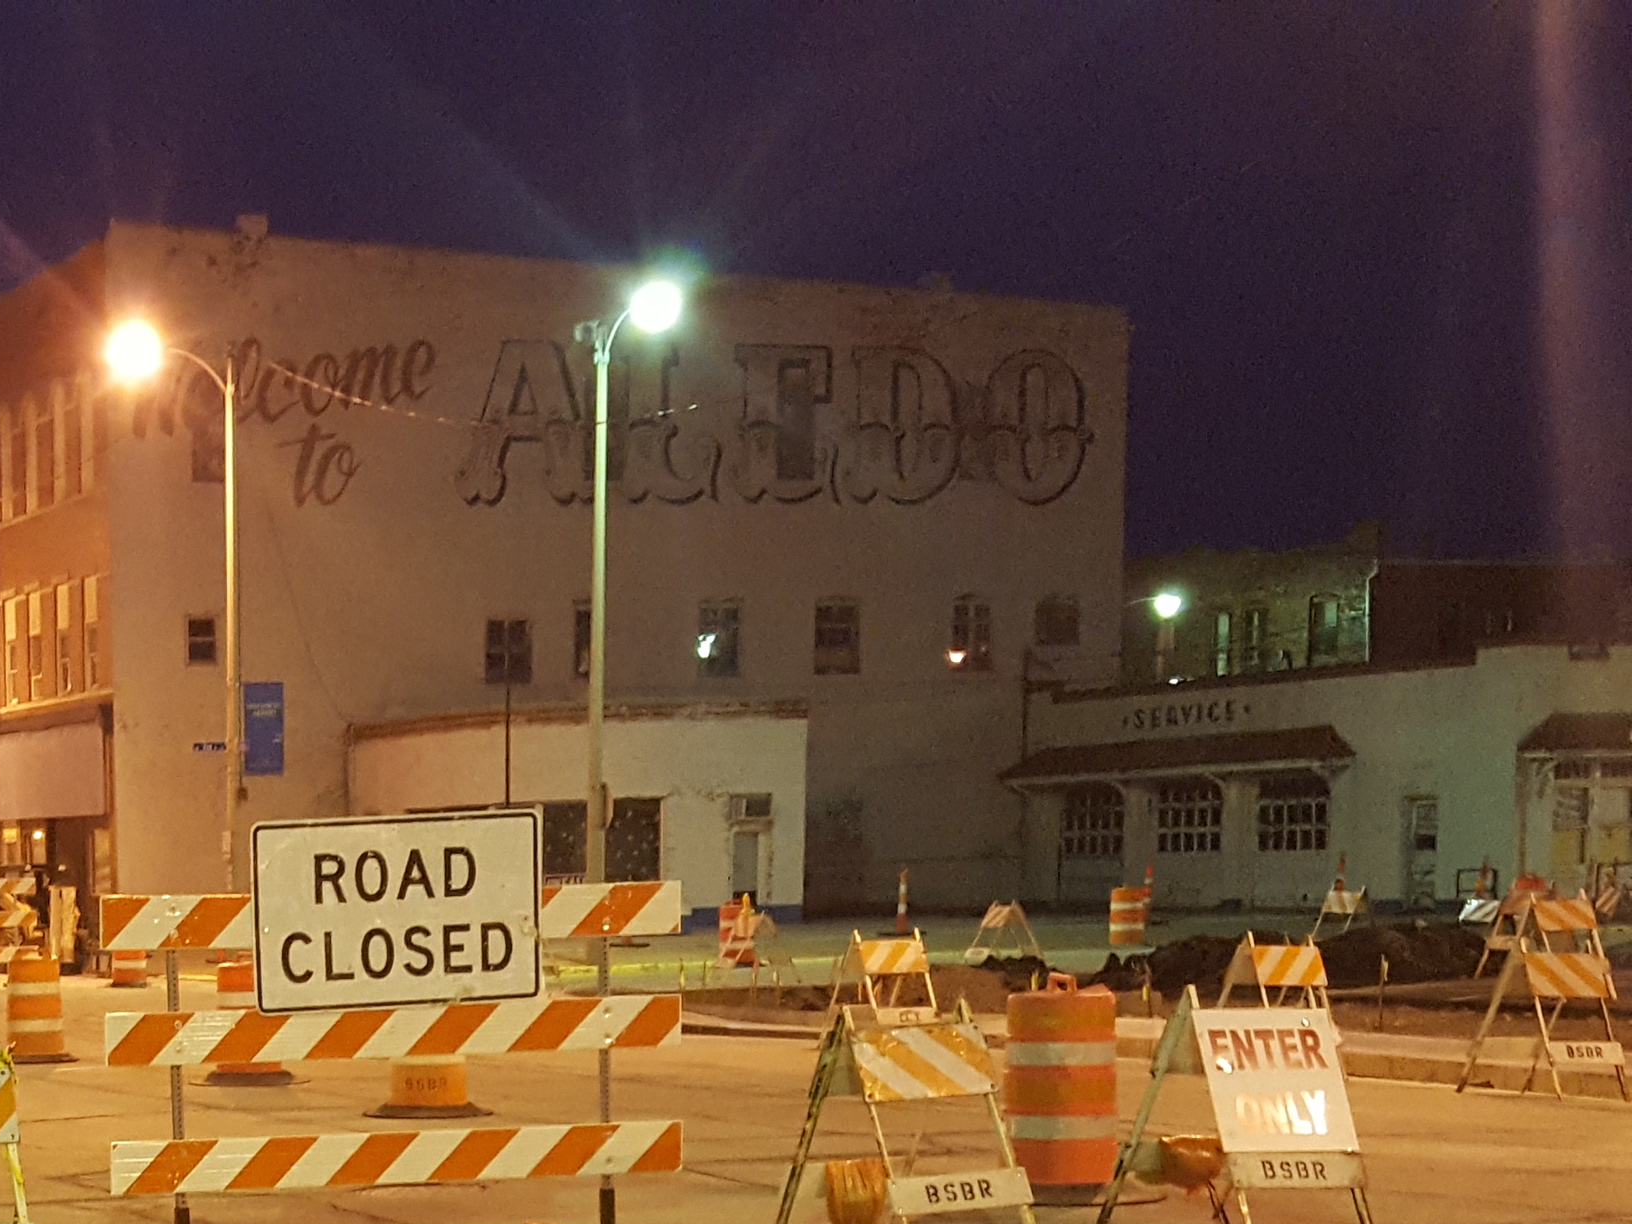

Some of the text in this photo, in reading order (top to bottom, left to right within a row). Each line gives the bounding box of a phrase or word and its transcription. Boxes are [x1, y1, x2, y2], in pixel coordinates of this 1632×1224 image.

[456, 340, 1096, 506] ALEDO
[278, 423, 361, 508] to
[1133, 700, 1235, 730] SERVICE
[313, 846, 476, 904] ROAD
[281, 922, 513, 983] CLOSED
[1207, 1028, 1329, 1072] ENTER
[1235, 1089, 1329, 1136] ONLY
[925, 1179, 993, 1203] BSBR
[1261, 1160, 1328, 1181] BSBR
